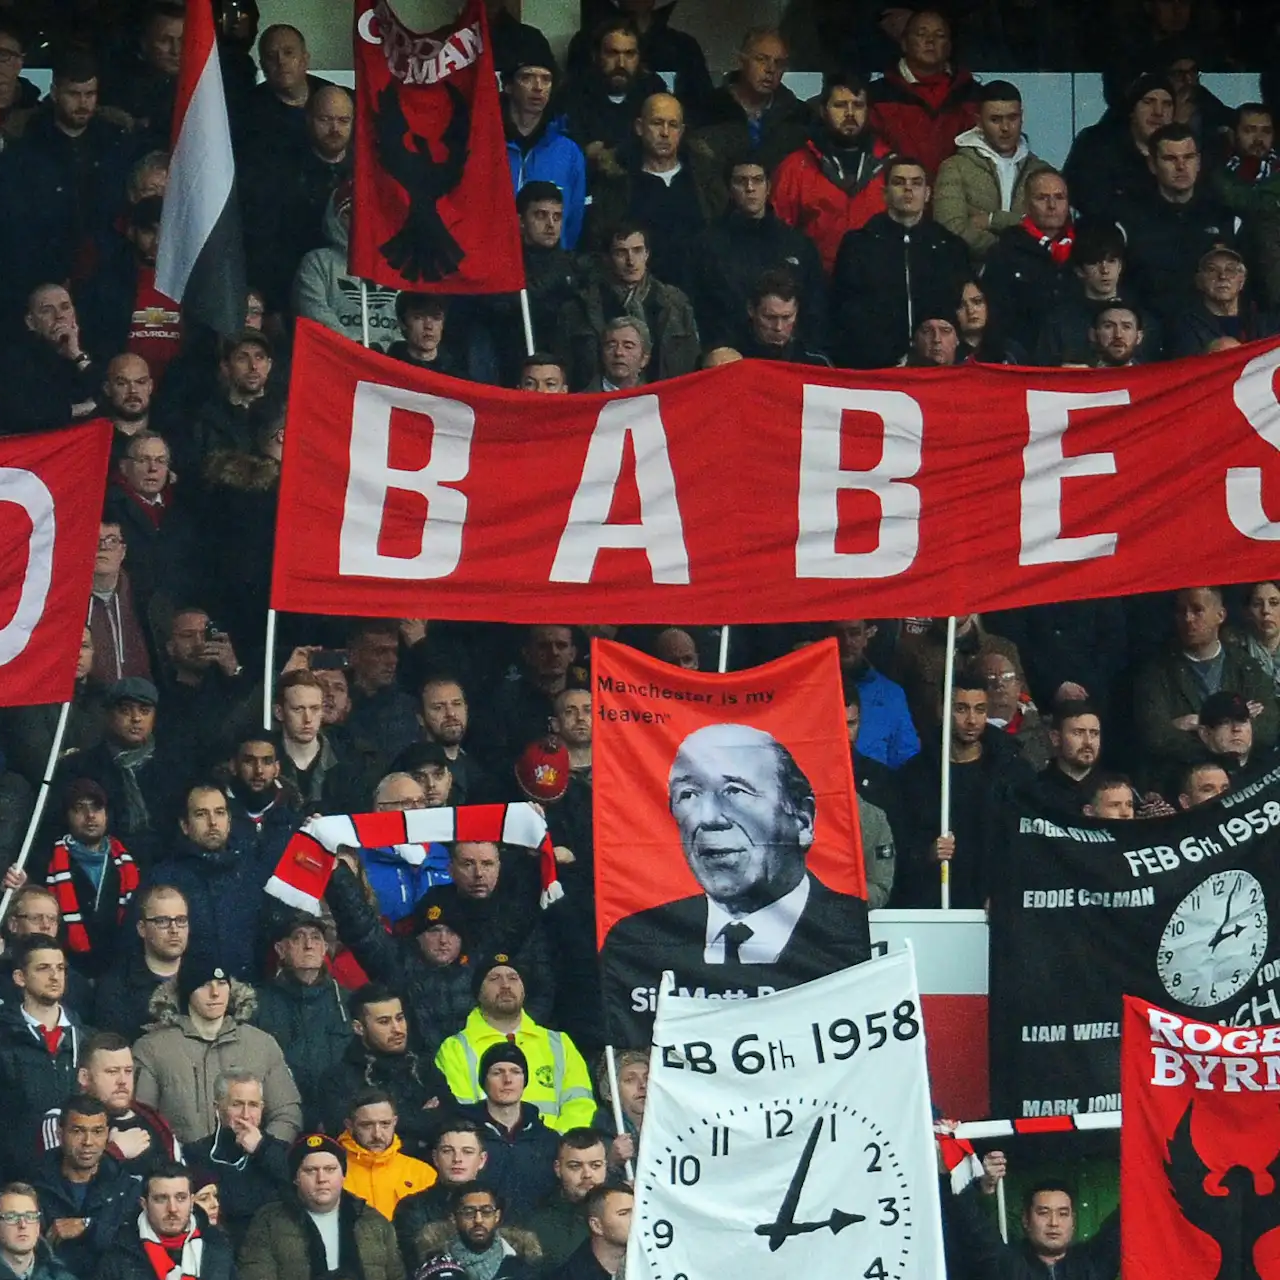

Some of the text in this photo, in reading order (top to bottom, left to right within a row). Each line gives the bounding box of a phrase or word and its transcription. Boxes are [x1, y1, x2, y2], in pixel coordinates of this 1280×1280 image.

[597, 677, 775, 705] Manchester is my
[1123, 800, 1280, 878] FEB 6th 1958
[1212, 880, 1225, 897] 12
[1250, 888, 1260, 905] 2
[1023, 889, 1075, 909] EDDIE
[1171, 920, 1185, 938] 10
[1254, 912, 1264, 929] 3
[1164, 951, 1174, 964] 9
[1250, 942, 1258, 957] 4
[1172, 972, 1182, 987] 8
[1231, 969, 1241, 984] 5
[1191, 987, 1201, 1001] 7
[1210, 981, 1218, 998] 6
[732, 1033, 795, 1075] 6th
[812, 1000, 920, 1064] 1958
[1022, 1025, 1067, 1042] LIAM
[1023, 1098, 1079, 1117] MARK
[765, 1109, 794, 1139] 12
[830, 1113, 837, 1142] 1
[711, 1126, 730, 1157] 11
[863, 1142, 883, 1173] 2
[670, 1155, 701, 1186] 10
[878, 1197, 900, 1226] 3
[653, 1219, 674, 1249] 9
